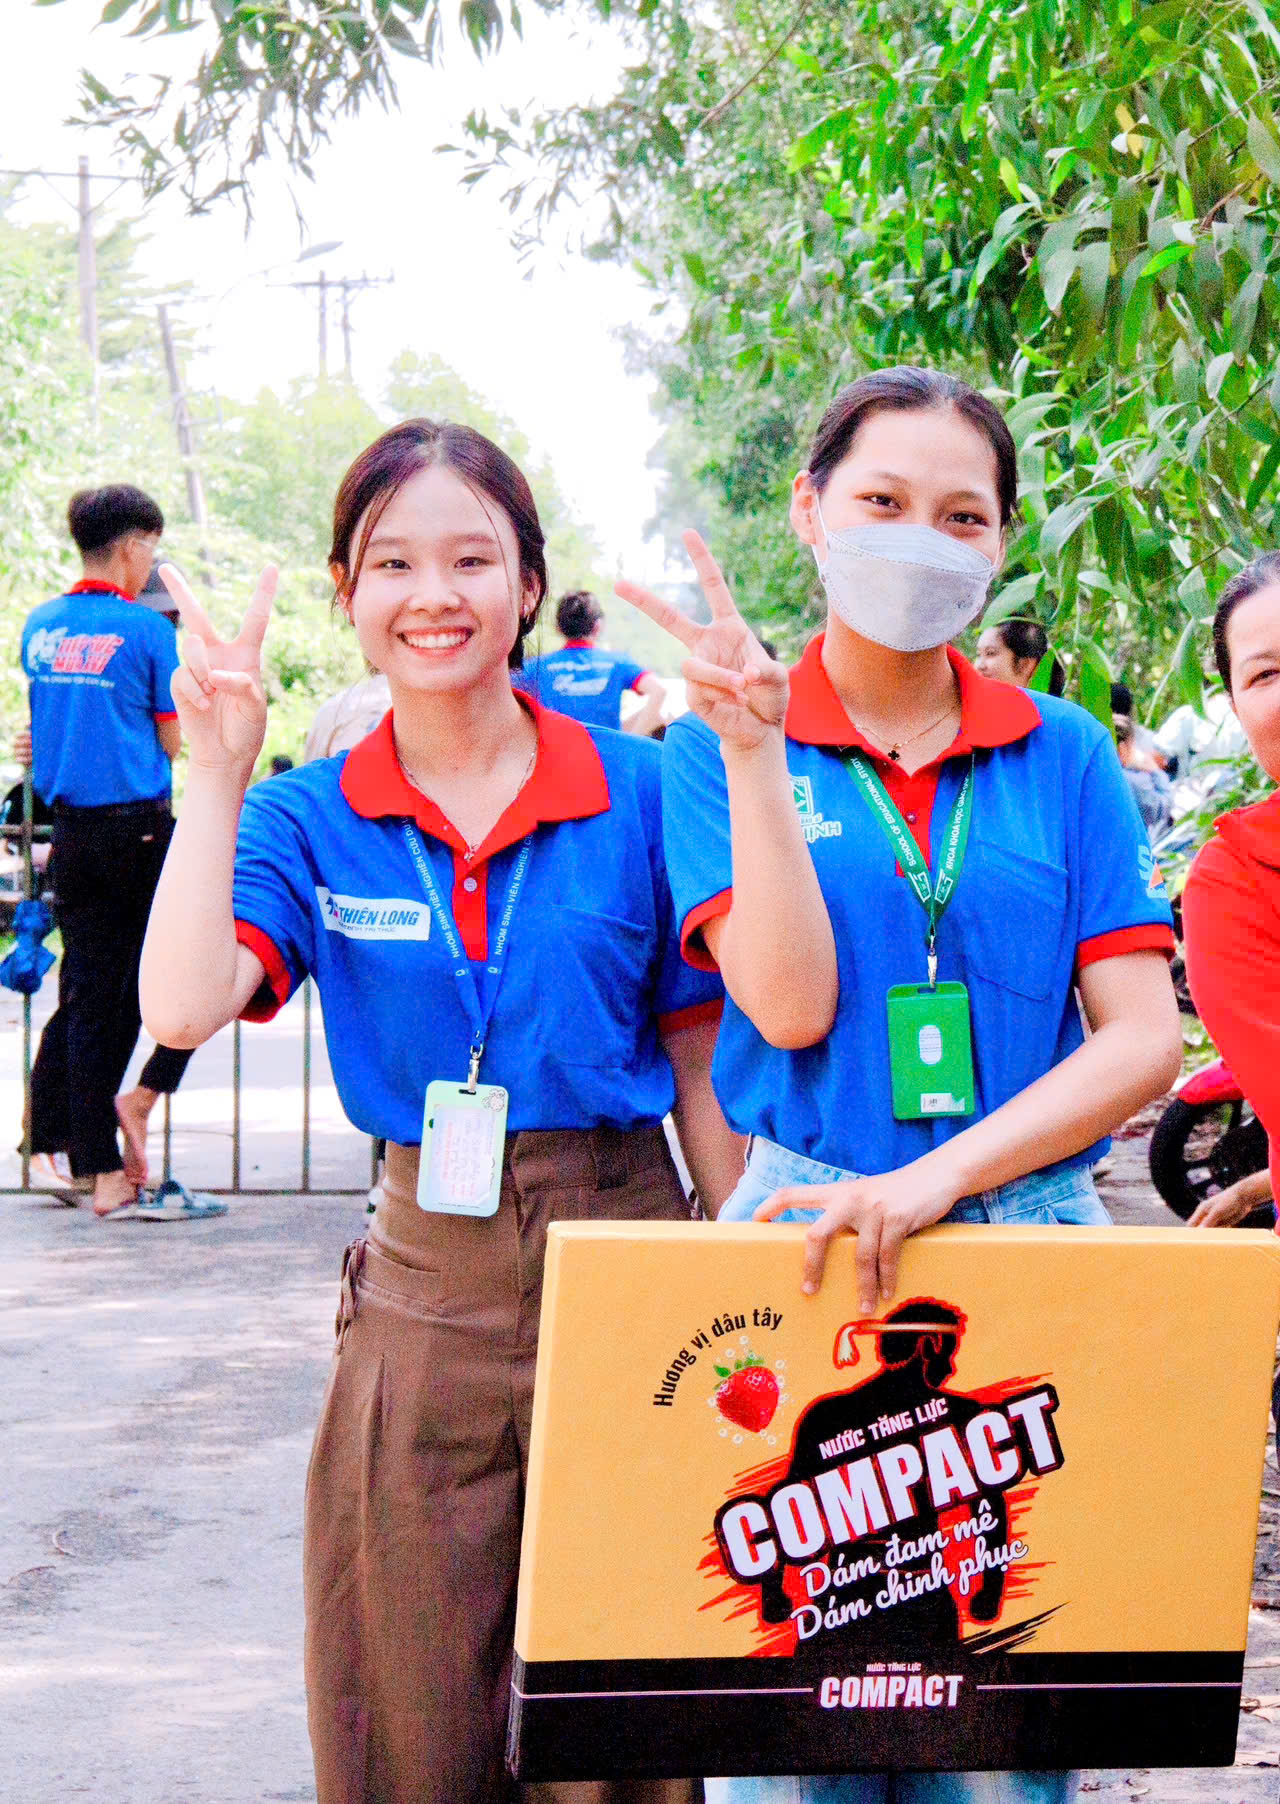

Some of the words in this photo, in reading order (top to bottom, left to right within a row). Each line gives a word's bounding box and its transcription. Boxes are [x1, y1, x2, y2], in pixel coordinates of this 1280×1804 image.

[851, 757, 869, 780] STUDY
[864, 780, 896, 824] EDUCATIONAL
[890, 824, 902, 835] OF
[950, 826, 961, 847] KHOA
[897, 835, 917, 867] SCHOOL
[945, 847, 957, 870] KHOA
[339, 906, 378, 926] THIÊN
[379, 910, 420, 926] LONG
[436, 910, 450, 930] SINH
[501, 905, 513, 926] SINH
[652, 1347, 698, 1407] Hương
[690, 1328, 713, 1350] vị
[711, 1313, 747, 1338] dâu
[752, 1307, 784, 1331] tây
[818, 1428, 867, 1460] NƯỚC
[868, 1414, 915, 1443] TĂNG
[916, 1397, 949, 1425] LỰC
[721, 1393, 1057, 1577] COMPACT
[800, 1553, 882, 1599] Dám
[885, 1529, 950, 1568] đam
[953, 1498, 999, 1544] mê
[790, 1595, 873, 1641] Dám
[876, 1552, 958, 1610] chinh
[957, 1536, 1030, 1596] phục
[820, 1675, 964, 1709] COMPACT
